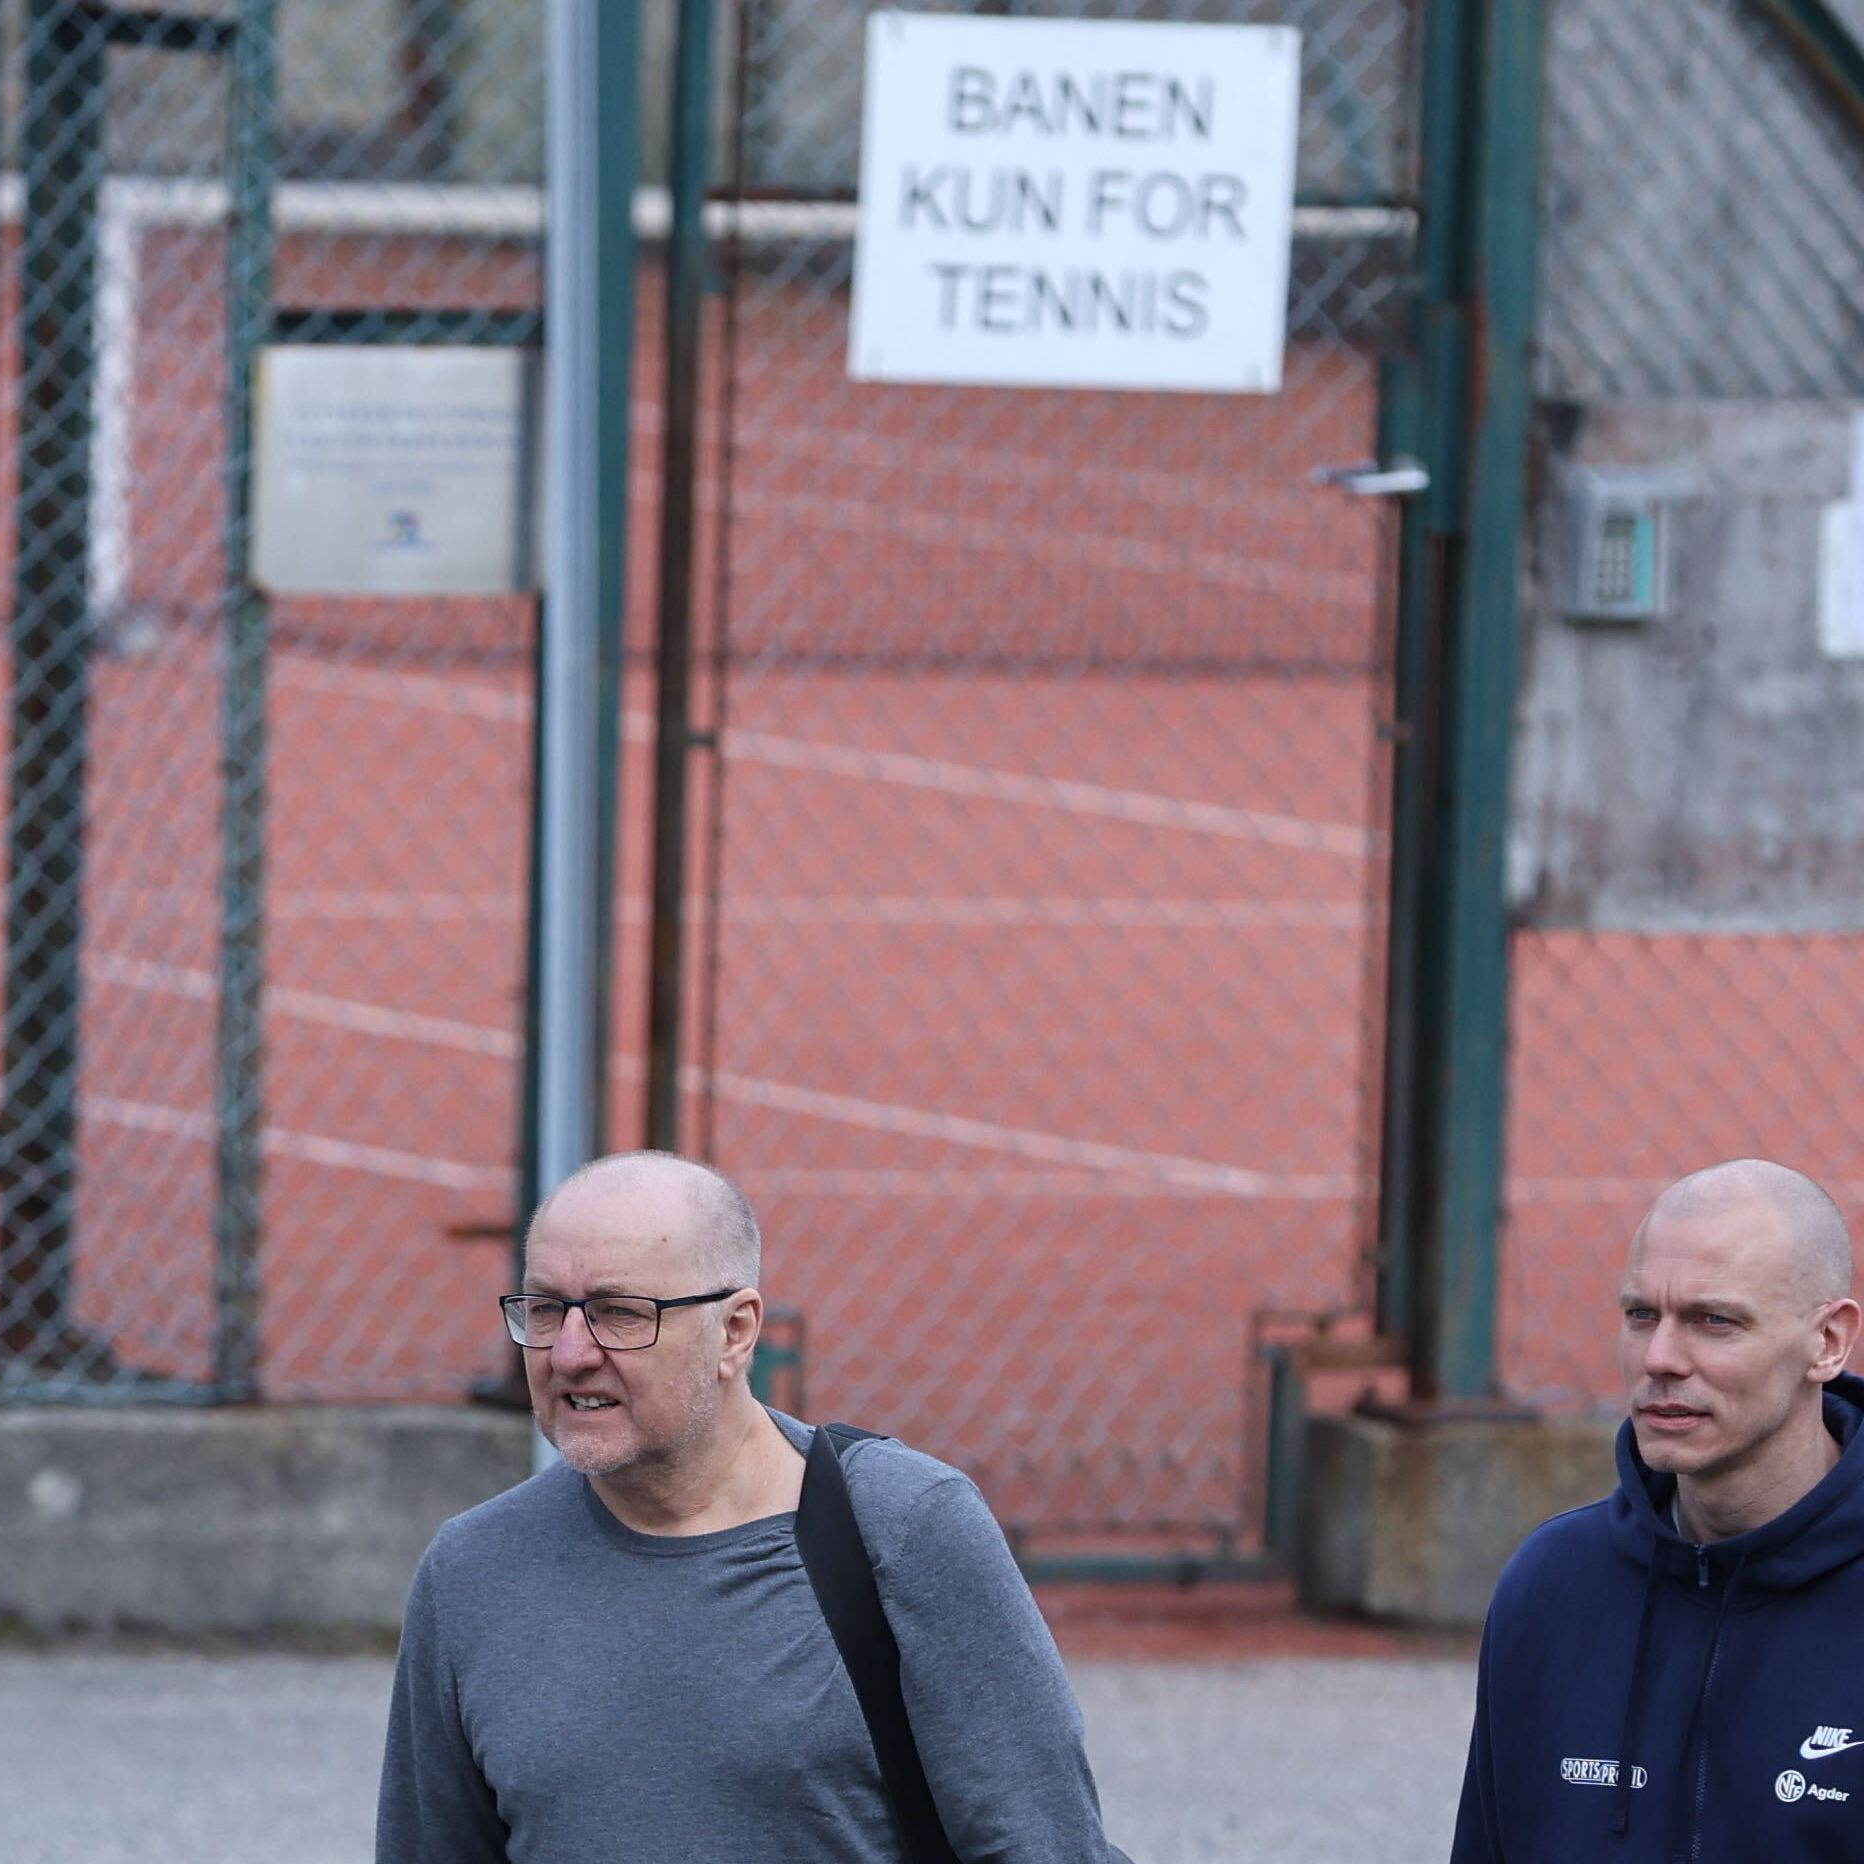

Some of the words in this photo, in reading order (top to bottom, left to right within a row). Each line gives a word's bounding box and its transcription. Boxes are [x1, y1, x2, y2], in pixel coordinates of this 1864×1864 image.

[948, 66, 1215, 141] BANEN
[899, 165, 1064, 232] KUN
[1087, 170, 1249, 240] FOR
[931, 264, 1211, 338] TENNIS
[1811, 1726, 1853, 1748] NIKE
[1807, 1783, 1850, 1801] Agder
